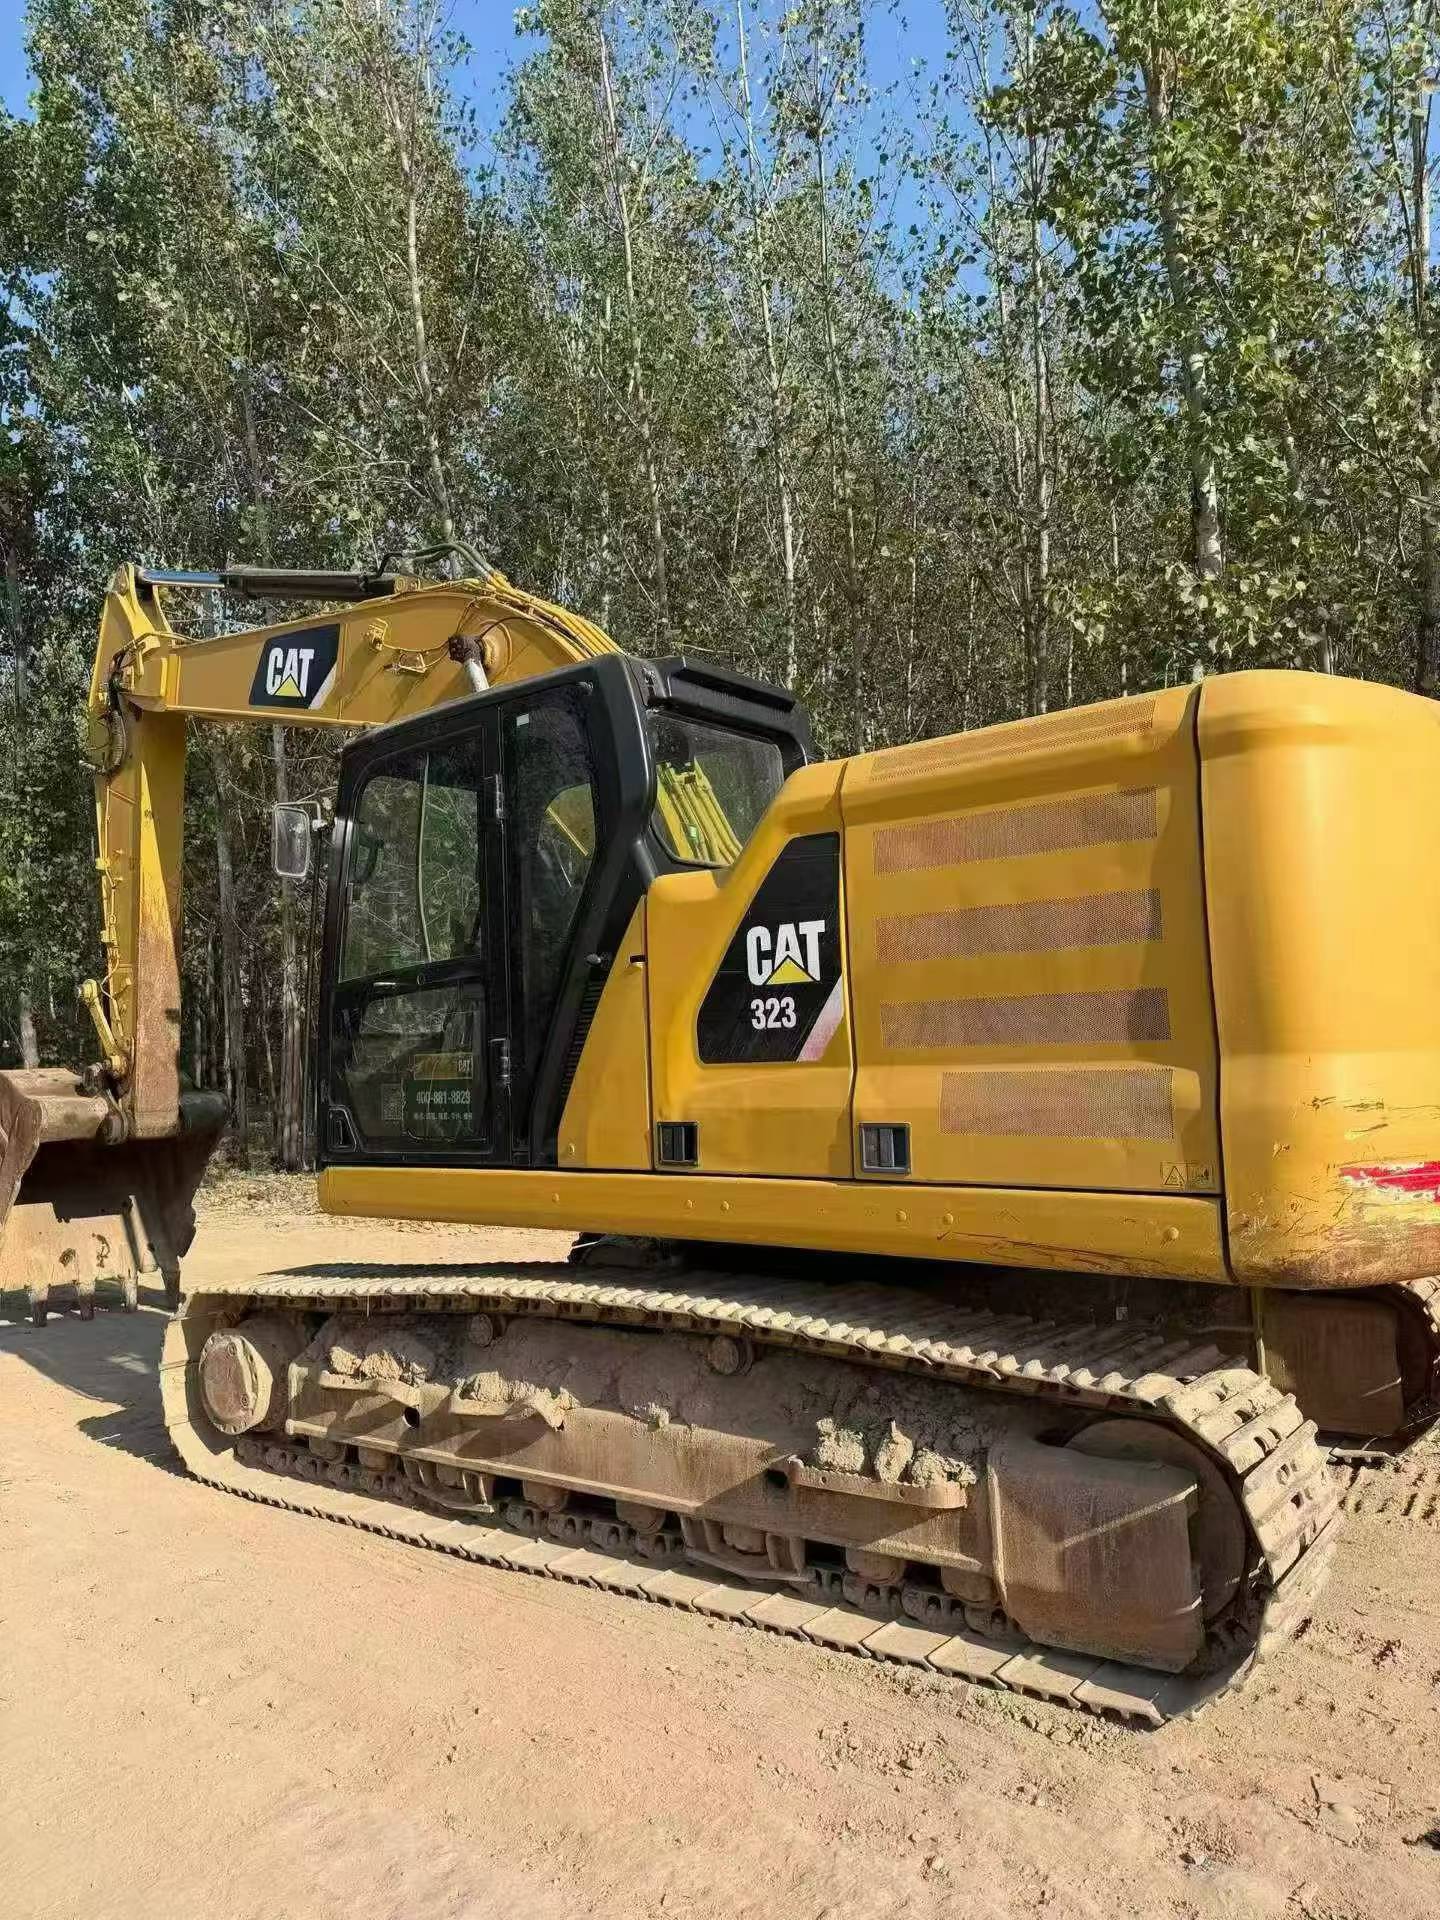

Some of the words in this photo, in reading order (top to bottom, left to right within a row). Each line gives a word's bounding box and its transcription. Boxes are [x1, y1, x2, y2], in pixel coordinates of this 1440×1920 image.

[266, 647, 315, 697] CAT
[746, 920, 825, 986] CAT
[750, 997, 797, 1030] 323
